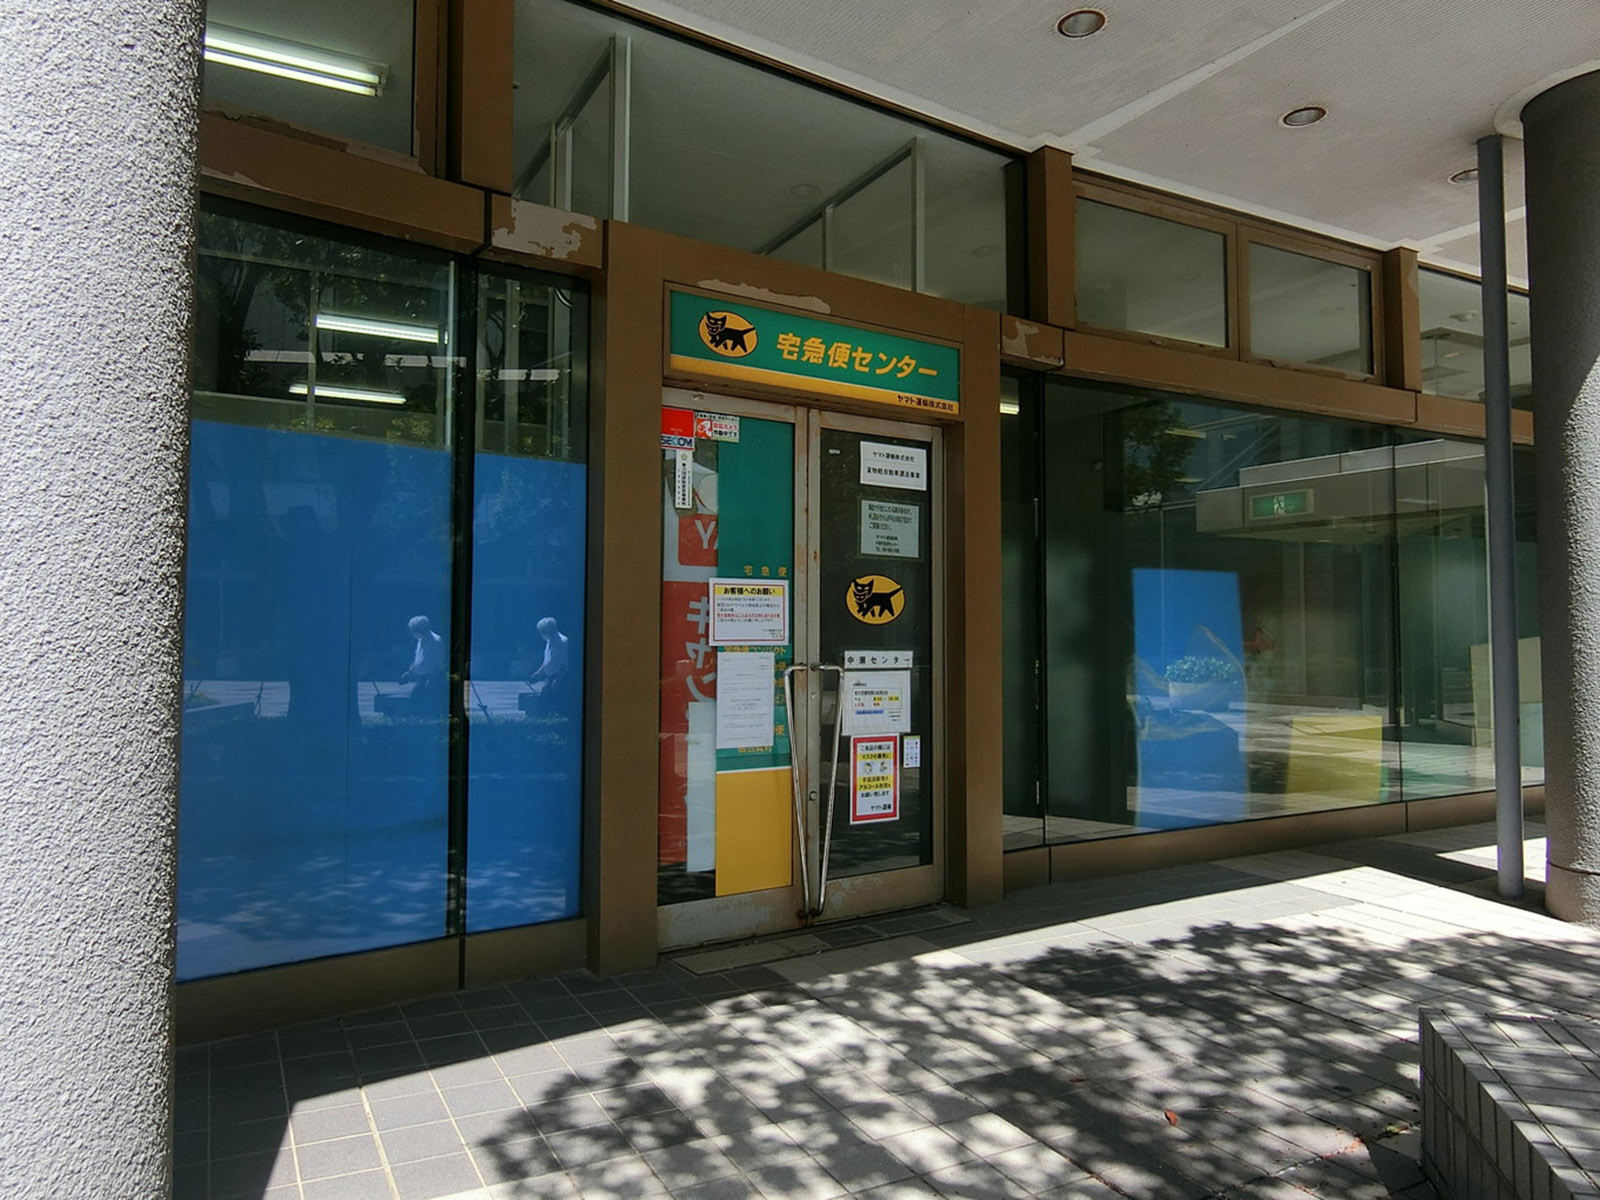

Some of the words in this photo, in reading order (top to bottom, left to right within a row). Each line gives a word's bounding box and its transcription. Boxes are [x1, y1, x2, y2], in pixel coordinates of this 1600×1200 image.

[776, 332, 938, 378] 宅急便センター
[896, 394, 954, 411] ヤマト運輸株式会社
[661, 435, 693, 448] SECOM
[723, 587, 776, 595] お客様へのお願い
